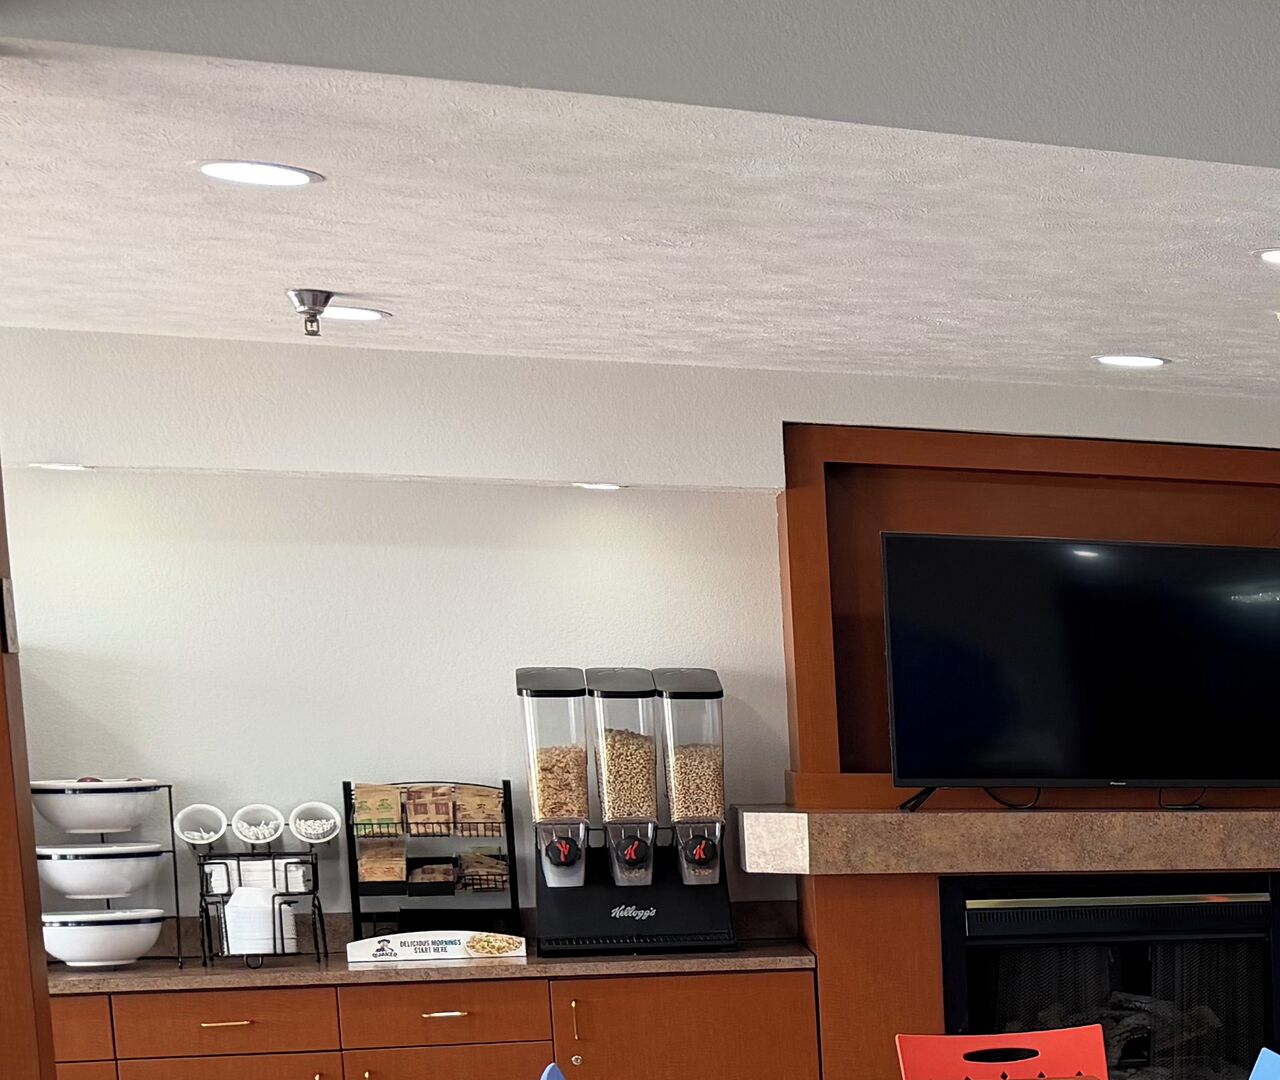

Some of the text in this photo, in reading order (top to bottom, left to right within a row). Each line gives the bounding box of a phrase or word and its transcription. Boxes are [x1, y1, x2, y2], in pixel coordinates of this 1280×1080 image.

[611, 904, 657, 920] Kellogg's
[399, 939, 462, 948] DELICIOUS MORNINGS
[414, 946, 448, 954] START HERE
